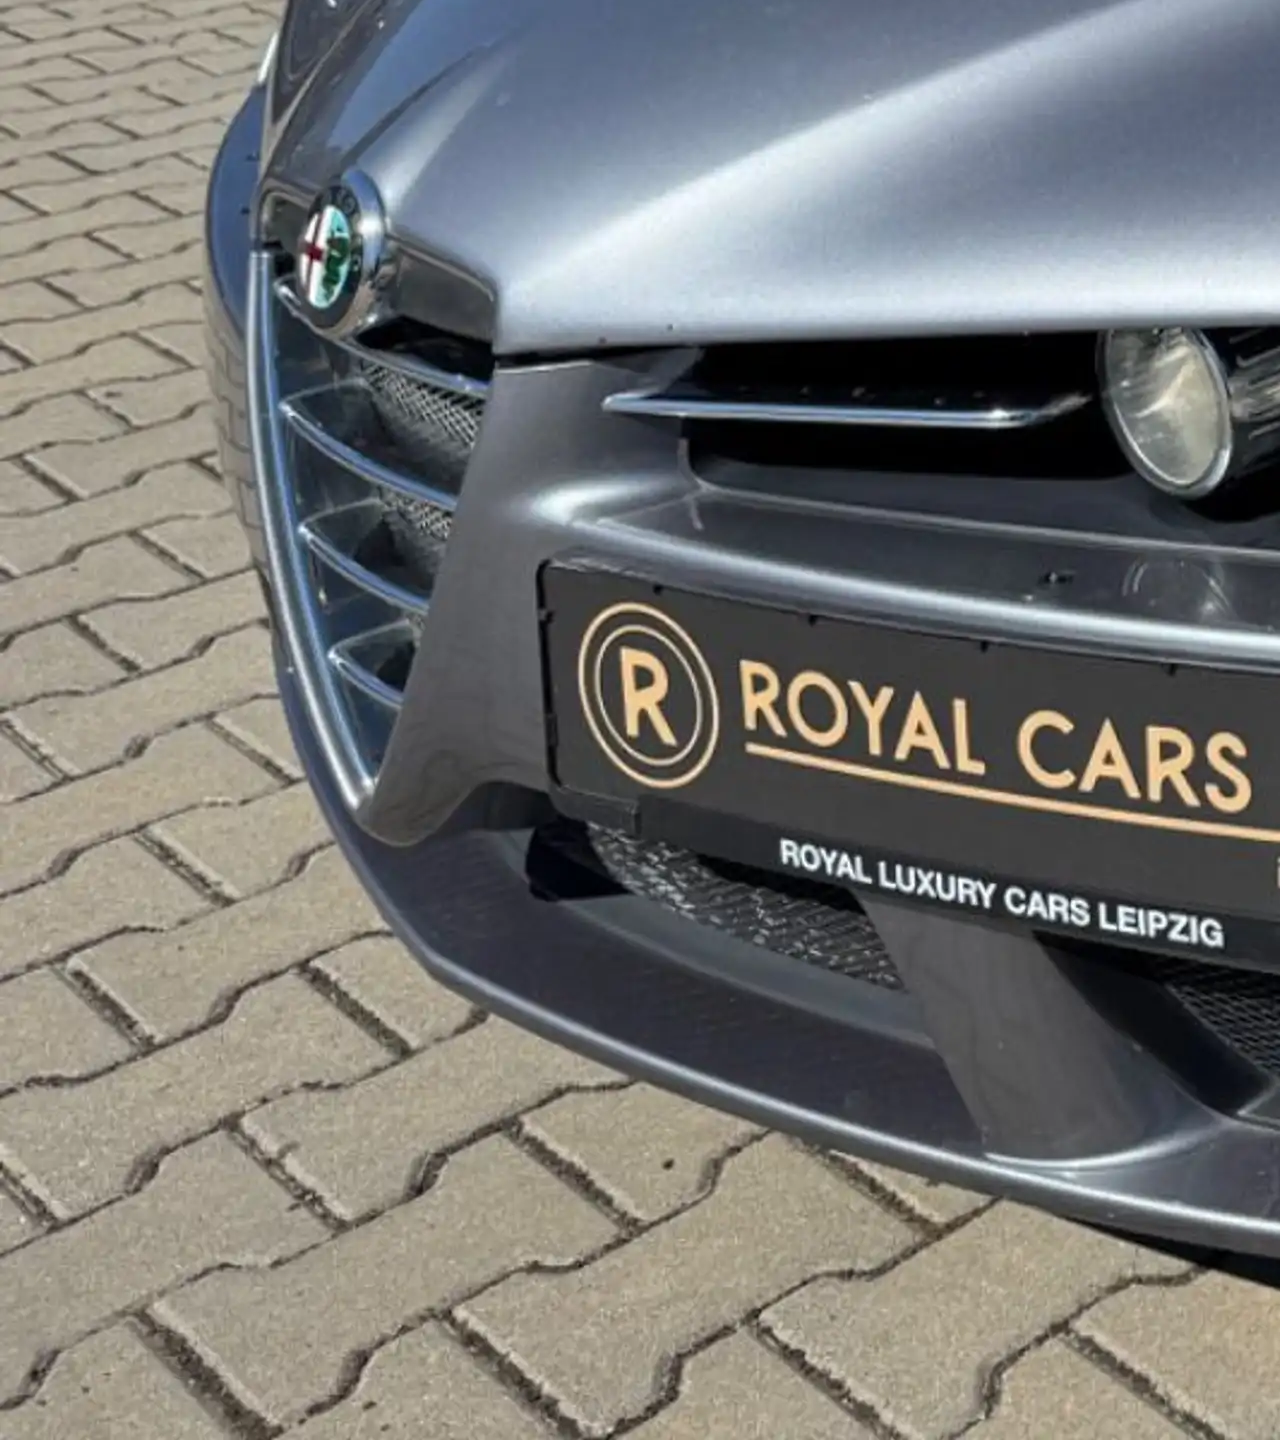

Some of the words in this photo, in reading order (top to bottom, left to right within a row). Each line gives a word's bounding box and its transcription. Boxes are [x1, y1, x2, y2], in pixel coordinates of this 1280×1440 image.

[619, 645, 679, 747] R
[739, 659, 986, 776] ROYAL
[1017, 709, 1252, 814] CARS
[779, 837, 873, 885] ROYAL
[878, 860, 998, 910] LUXURY
[1003, 885, 1092, 927] CARS
[1098, 901, 1225, 949] LEIPZIG
